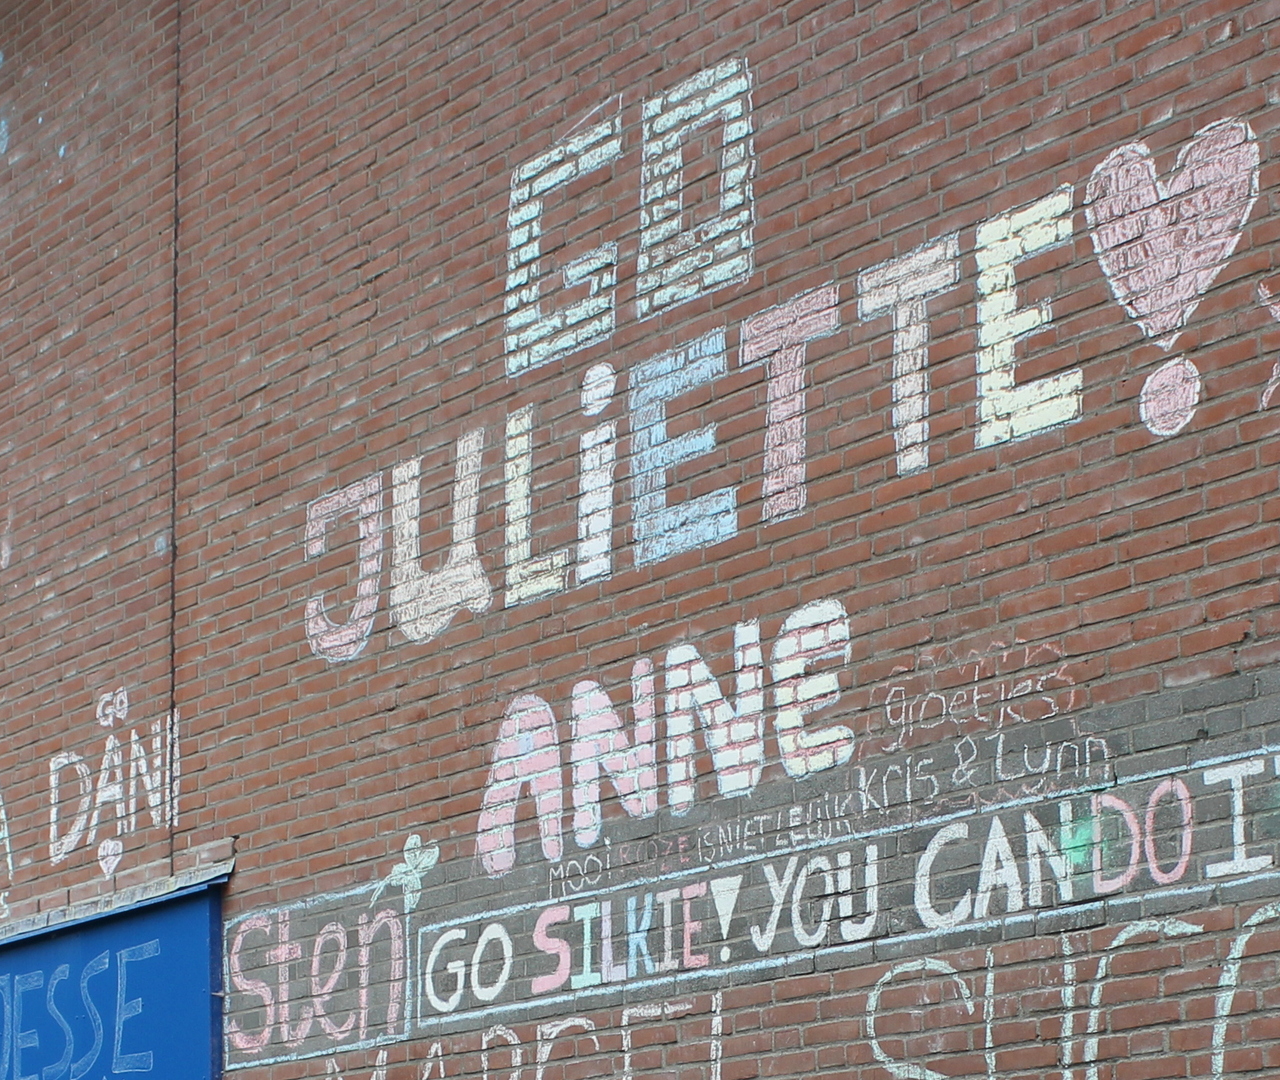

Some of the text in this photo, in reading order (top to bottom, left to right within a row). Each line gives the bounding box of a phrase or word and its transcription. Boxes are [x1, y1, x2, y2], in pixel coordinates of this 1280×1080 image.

[505, 57, 755, 382] GO
[476, 598, 856, 878] ANNE
[227, 908, 406, 1053] Sten
[425, 924, 513, 1011] GO
[750, 844, 878, 953] YOU
[915, 800, 1073, 929] CAN
[1090, 777, 1194, 892] DO
